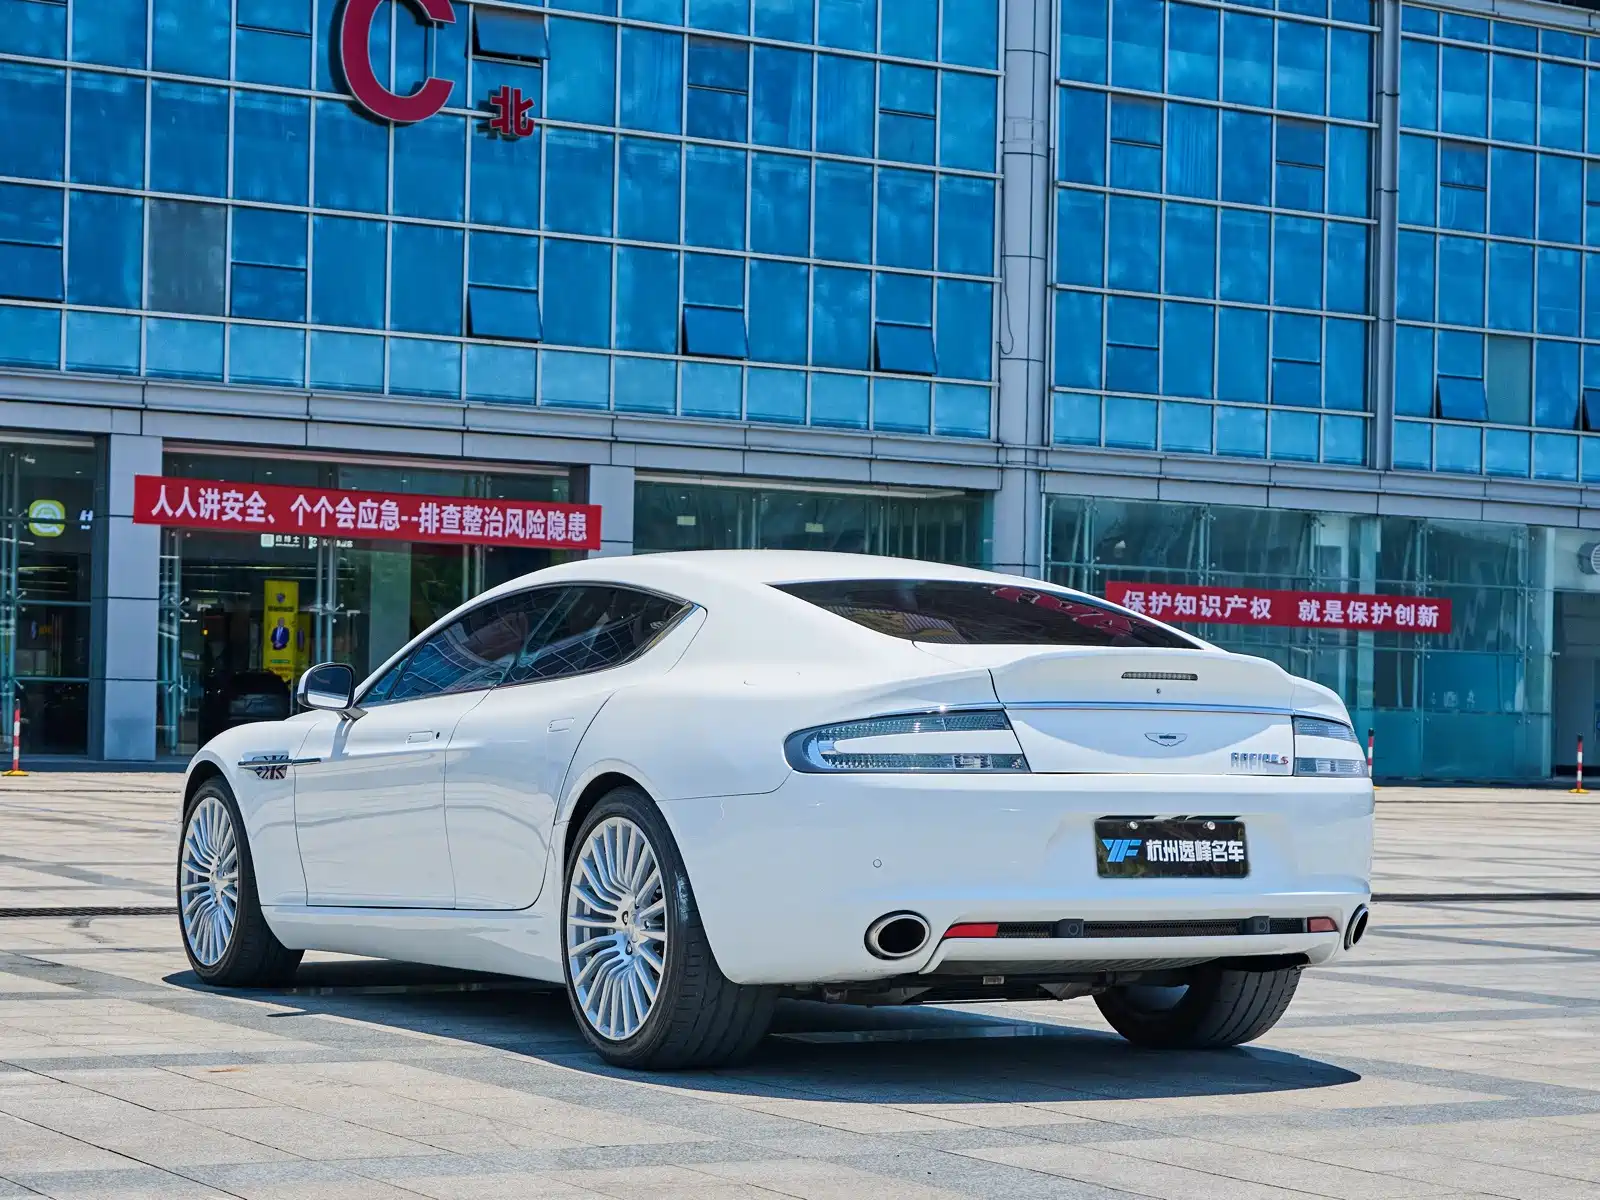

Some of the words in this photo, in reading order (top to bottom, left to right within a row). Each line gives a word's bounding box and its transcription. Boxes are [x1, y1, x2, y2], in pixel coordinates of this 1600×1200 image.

[341, 0, 456, 122] C
[490, 85, 535, 136] 北
[1122, 590, 1272, 619] 保护知识产权
[1298, 599, 1440, 628] 就是保护创新
[1146, 839, 1245, 863] 杭州逸峰名车
